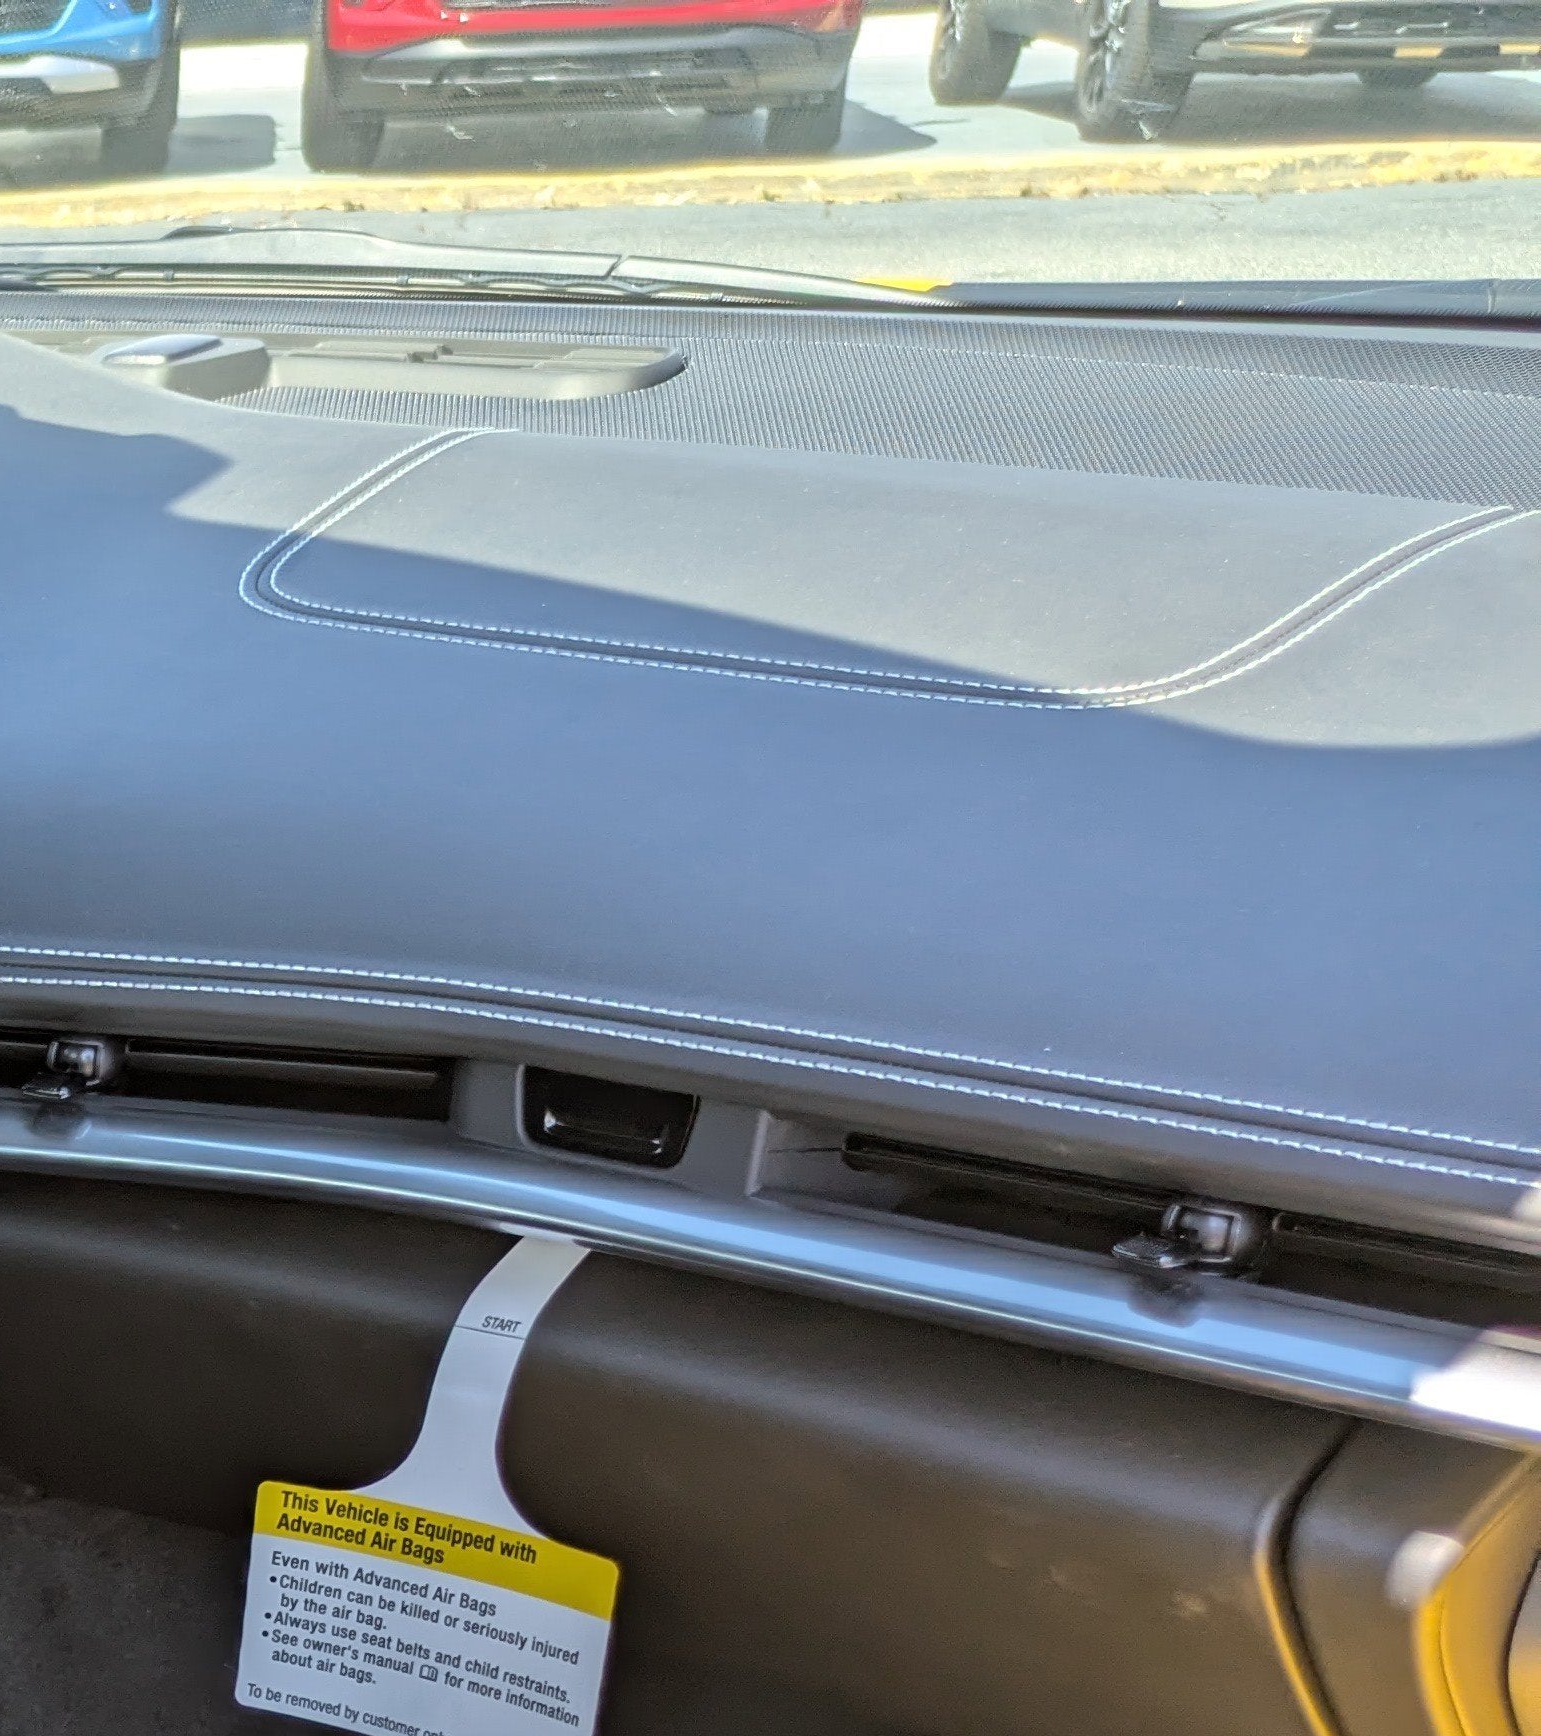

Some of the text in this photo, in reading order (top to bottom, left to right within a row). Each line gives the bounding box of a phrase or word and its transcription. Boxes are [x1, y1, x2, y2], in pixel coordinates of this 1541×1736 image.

[482, 1315, 522, 1333] START
[276, 1513, 445, 1565] Advanced Air Bags
[281, 1490, 537, 1564] This Vehicle is Equipped with
[271, 1550, 496, 1617] Even with Advanced Air Bags
[280, 1593, 387, 1630] by the air bag.
[279, 1574, 580, 1665] Children can be killed or seriously injured
[271, 1649, 376, 1684] about air bags.
[271, 1629, 580, 1727] See owner's manual for more information
[273, 1611, 571, 1704] Always use seat belts and child restraints.
[247, 1682, 262, 1698] To
[265, 1687, 282, 1703] be
[285, 1693, 341, 1717] removed
[344, 1704, 360, 1724] by
